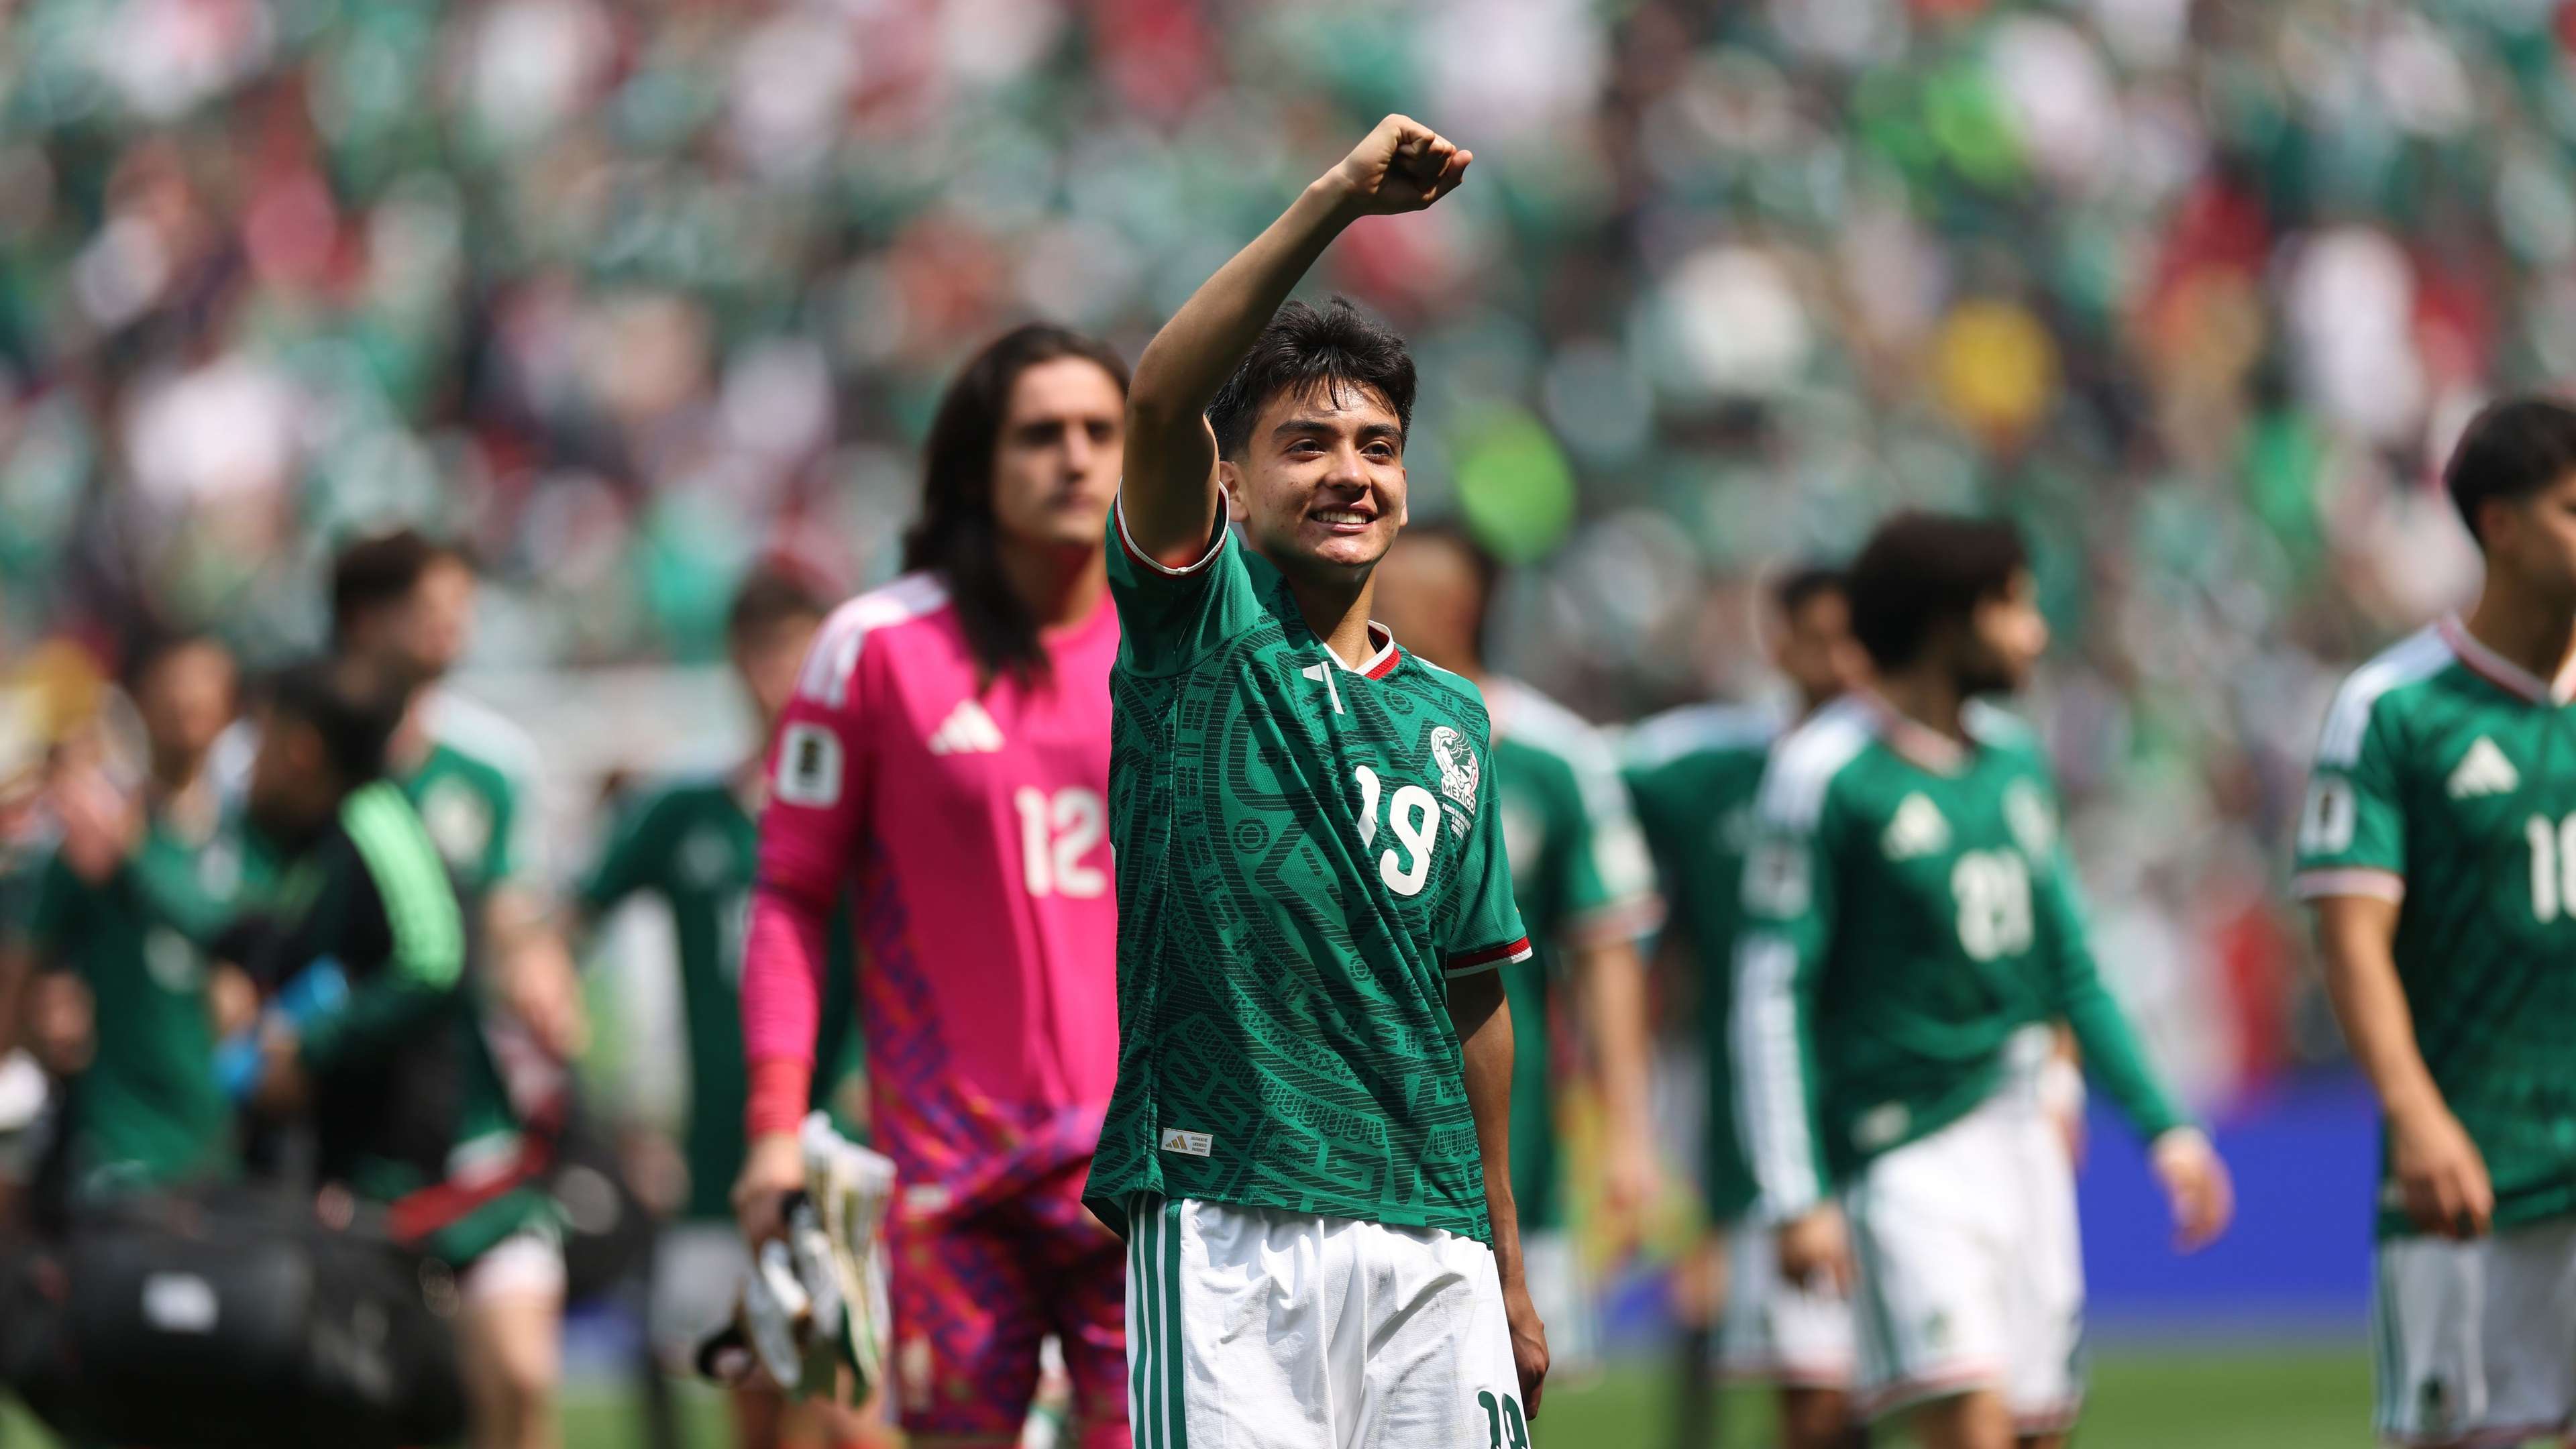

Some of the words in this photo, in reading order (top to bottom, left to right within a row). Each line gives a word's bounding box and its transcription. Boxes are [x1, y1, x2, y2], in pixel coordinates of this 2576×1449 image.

[1014, 786, 1107, 898] 12
[1355, 765, 1440, 896] 19
[1443, 782, 1475, 812] MÉXICO
